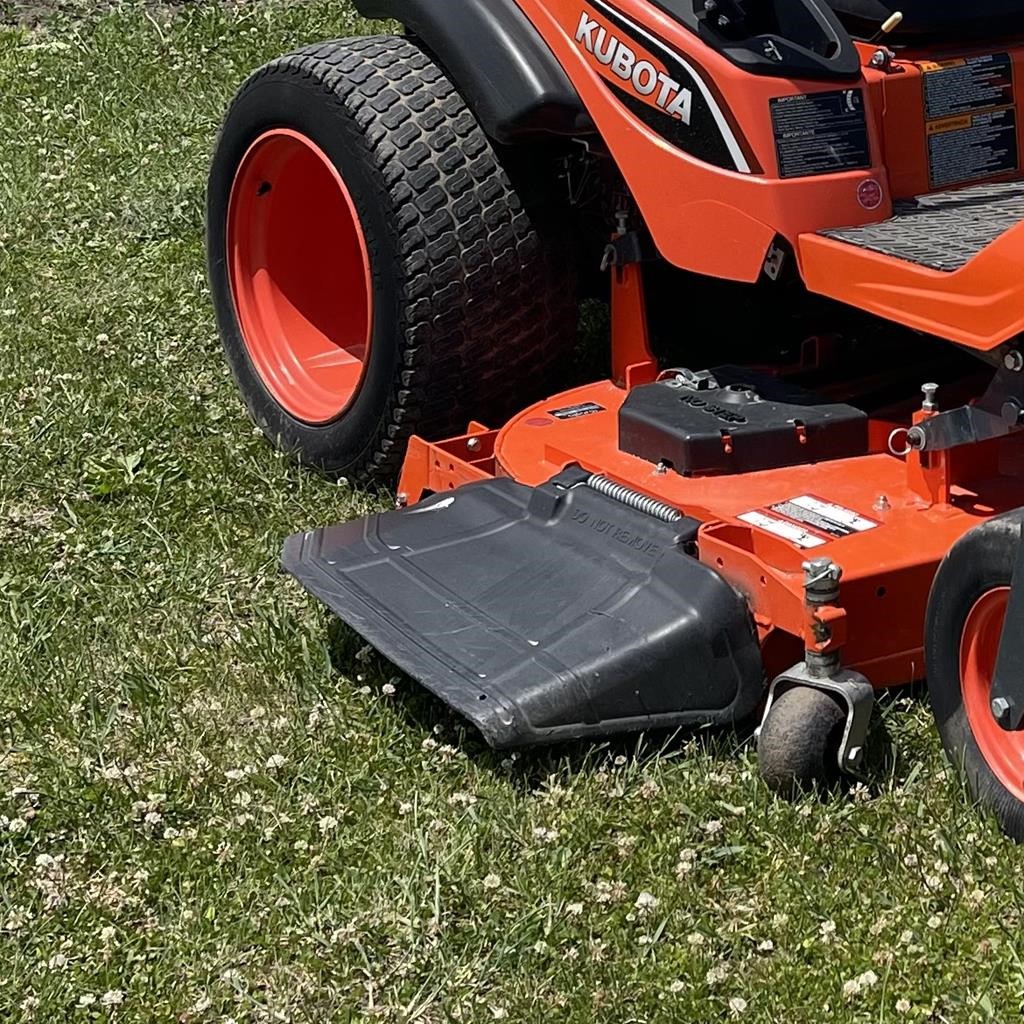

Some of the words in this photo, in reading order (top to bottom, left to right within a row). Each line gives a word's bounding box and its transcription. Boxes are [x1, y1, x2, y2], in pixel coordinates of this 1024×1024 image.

[575, 11, 692, 126] KUBOTA
[679, 395, 709, 408] NO
[590, 519, 615, 535] NOT
[611, 528, 660, 558] REMOVE
